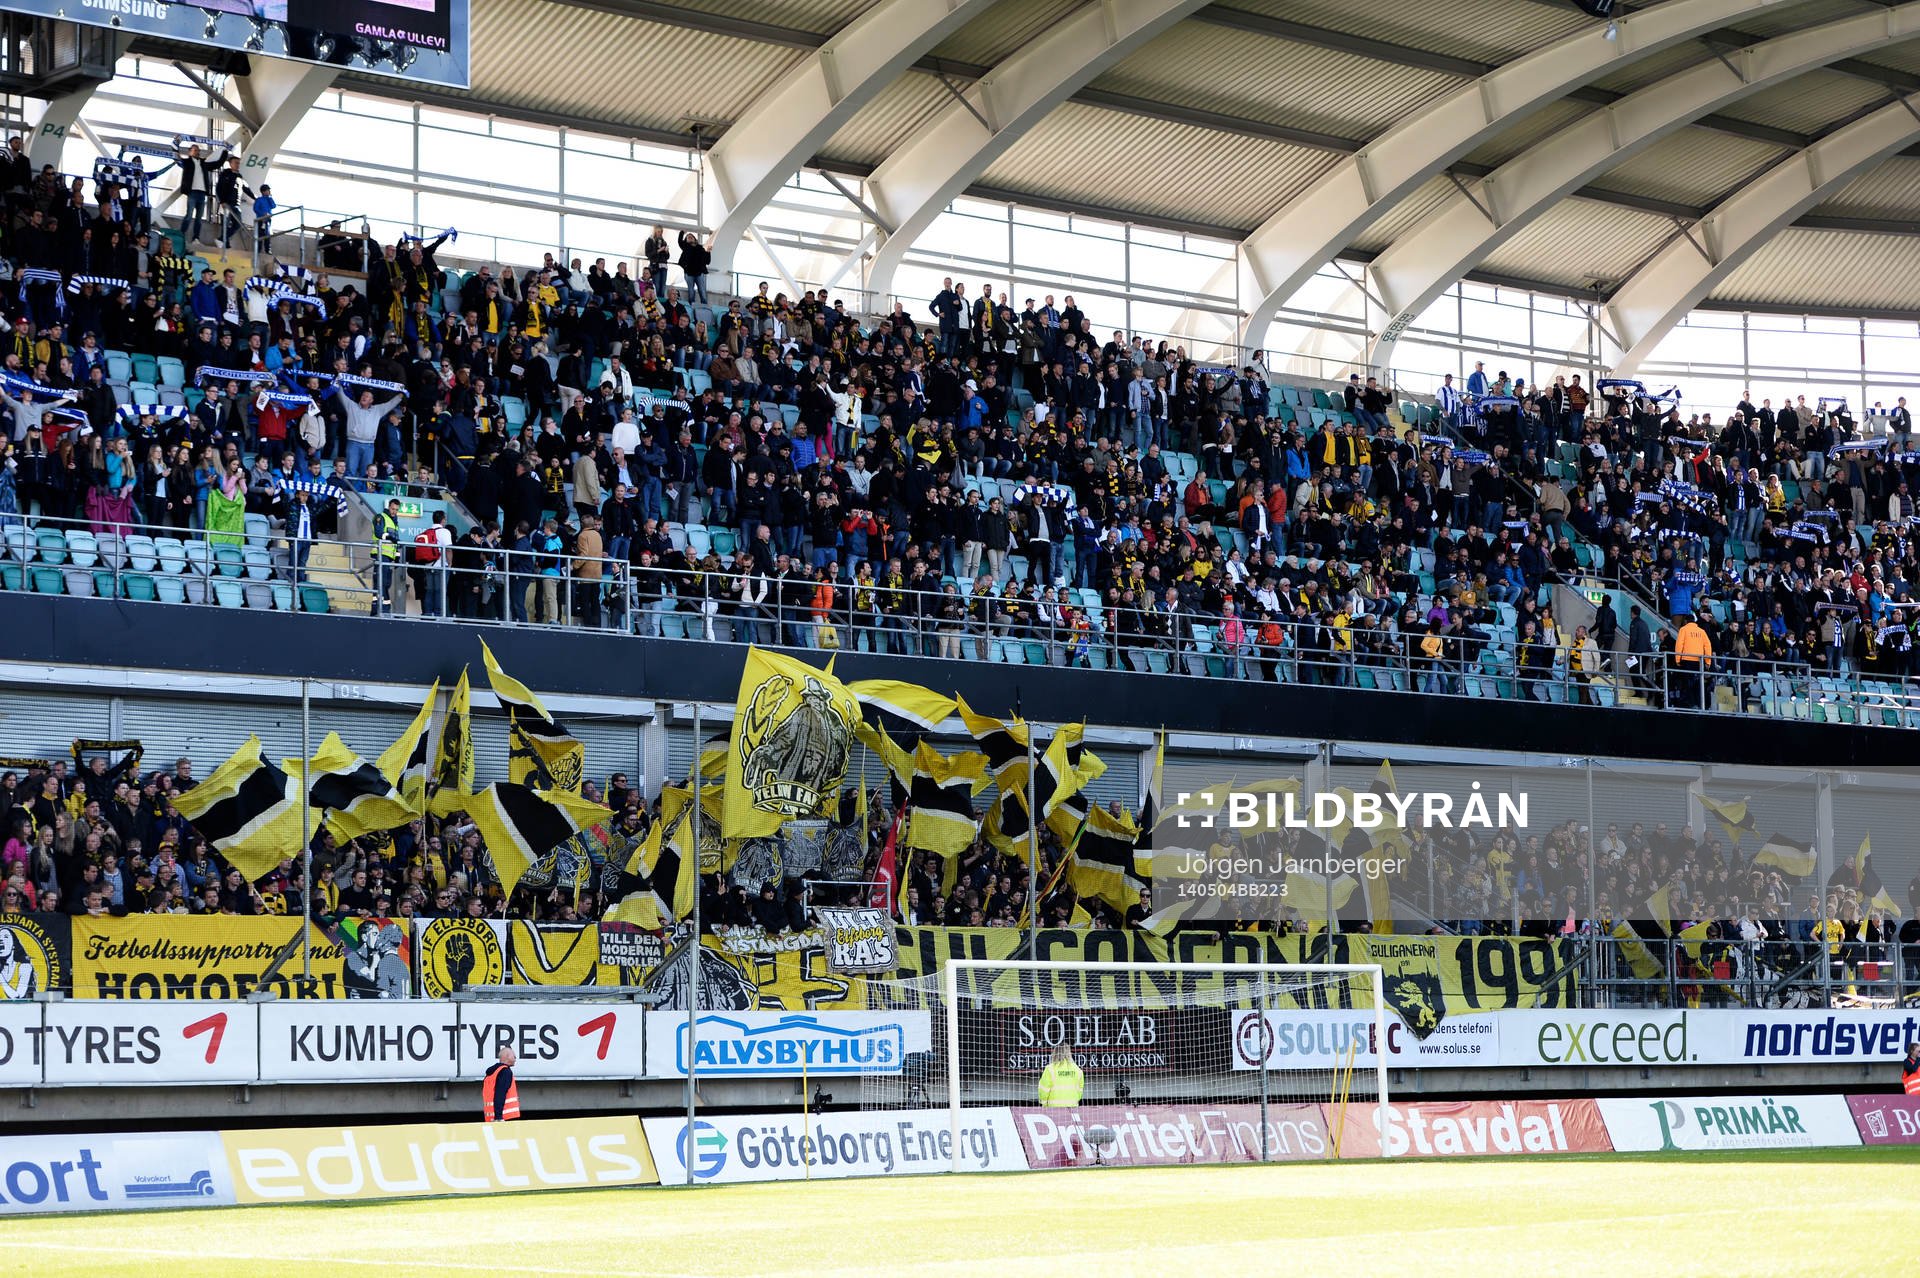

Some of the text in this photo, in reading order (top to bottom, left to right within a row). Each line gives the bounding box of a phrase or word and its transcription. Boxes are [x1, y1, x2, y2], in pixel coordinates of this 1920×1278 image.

[355, 22, 446, 48] GAMLA ULLEVI
[41, 122, 65, 139] P4
[246, 154, 269, 169] B4
[1382, 331, 1399, 343] B4
[1239, 738, 1253, 750] A4
[0, 914, 45, 938] LSVARTA
[433, 917, 497, 955] ELFSBORG
[601, 932, 661, 946] TILL DEN
[836, 926, 885, 945] Elfsborg
[601, 943, 661, 957] MODERNA
[1073, 1015, 1111, 1047] EL
[1116, 1014, 1157, 1046] AB
[1459, 1022, 1493, 1034] telefoni
[1538, 1011, 1698, 1063] exceed.
[1744, 1016, 1920, 1057] nordsvet
[24, 1026, 160, 1065] TYRES
[290, 1024, 559, 1062] KUMHO TYRES
[694, 1038, 893, 1065] ÄLVSBYHUS
[1419, 1043, 1481, 1054] www.solus.se
[1089, 1055, 1099, 1067] &
[1101, 1053, 1166, 1067] OLOFSSON
[1373, 1103, 1569, 1156] Stavdal
[1694, 1097, 1808, 1136] PRIMÄR
[737, 1119, 998, 1173] Göteborg Energi
[237, 1126, 642, 1198] eductus
[0, 1149, 109, 1204] ort
